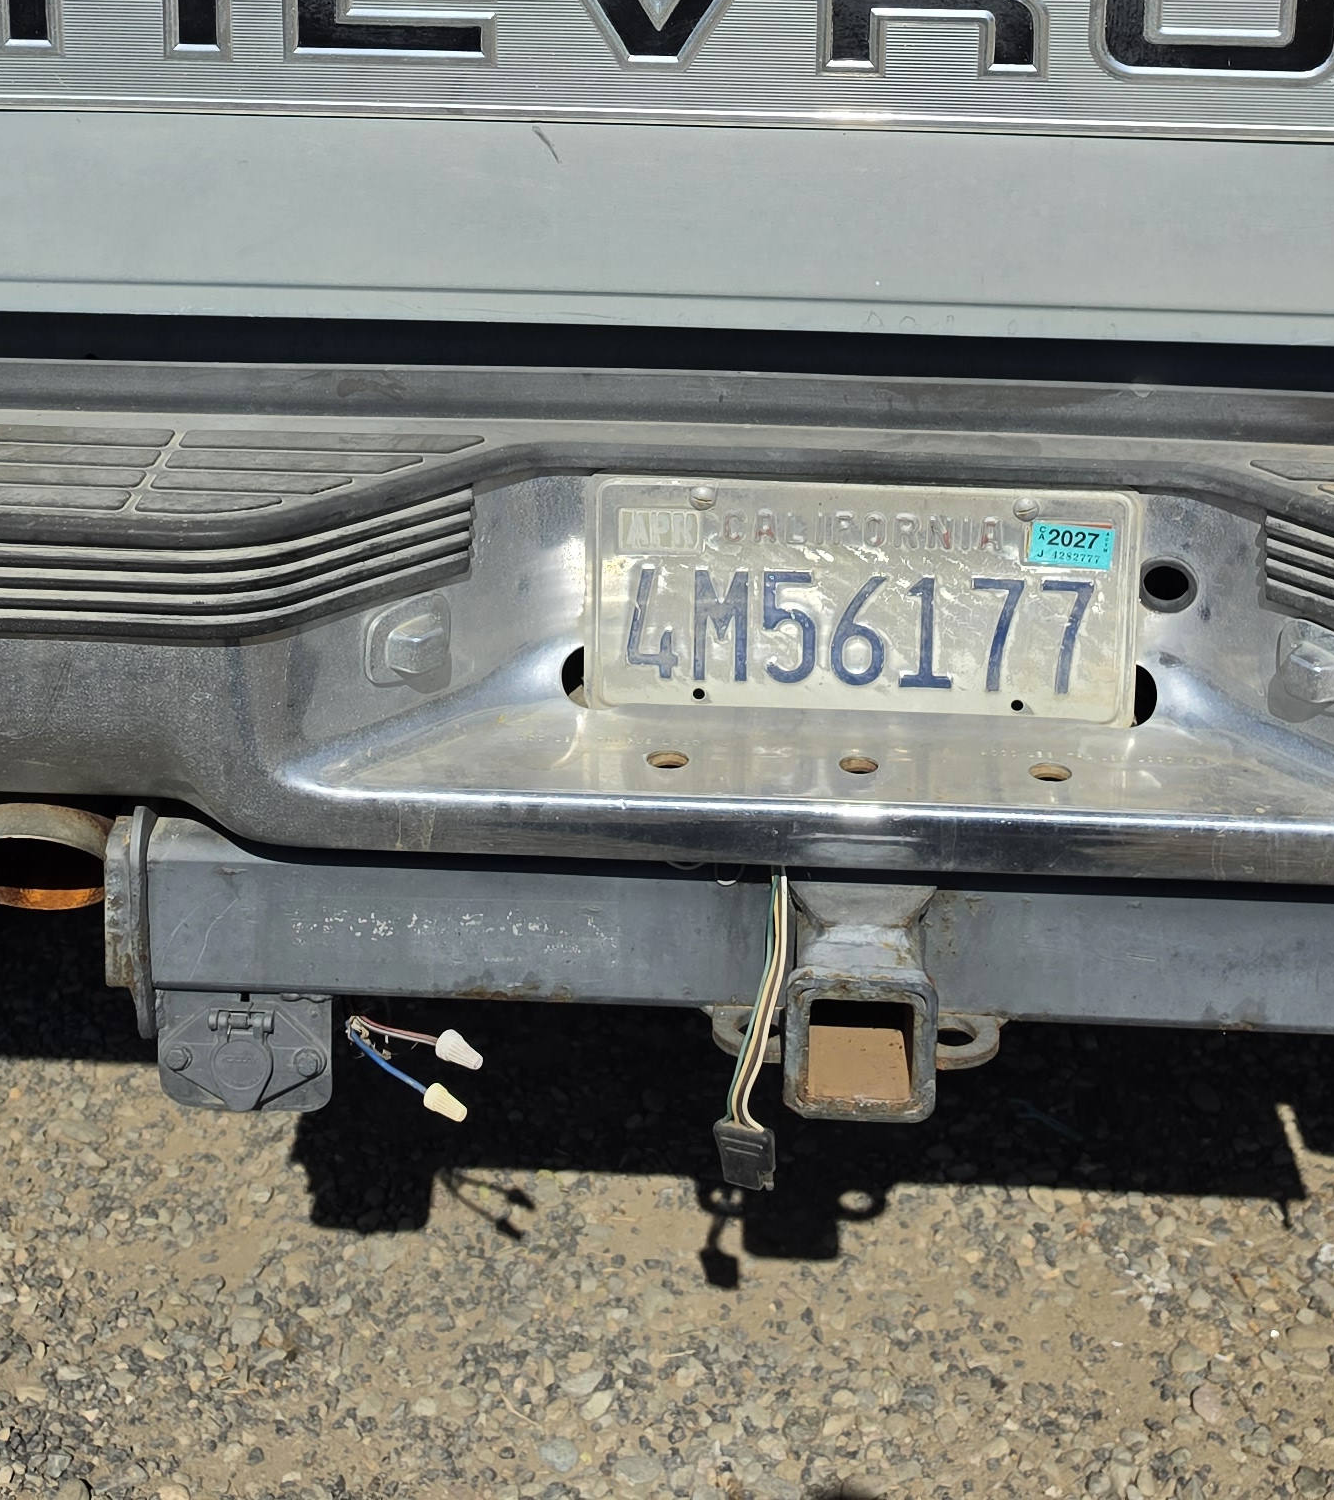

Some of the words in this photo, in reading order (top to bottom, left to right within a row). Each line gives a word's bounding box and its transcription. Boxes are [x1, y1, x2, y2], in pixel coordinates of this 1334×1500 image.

[723, 508, 1003, 550] CALIFORNIA
[1047, 528, 1100, 550] 2027
[625, 566, 1095, 695] 4M56177
